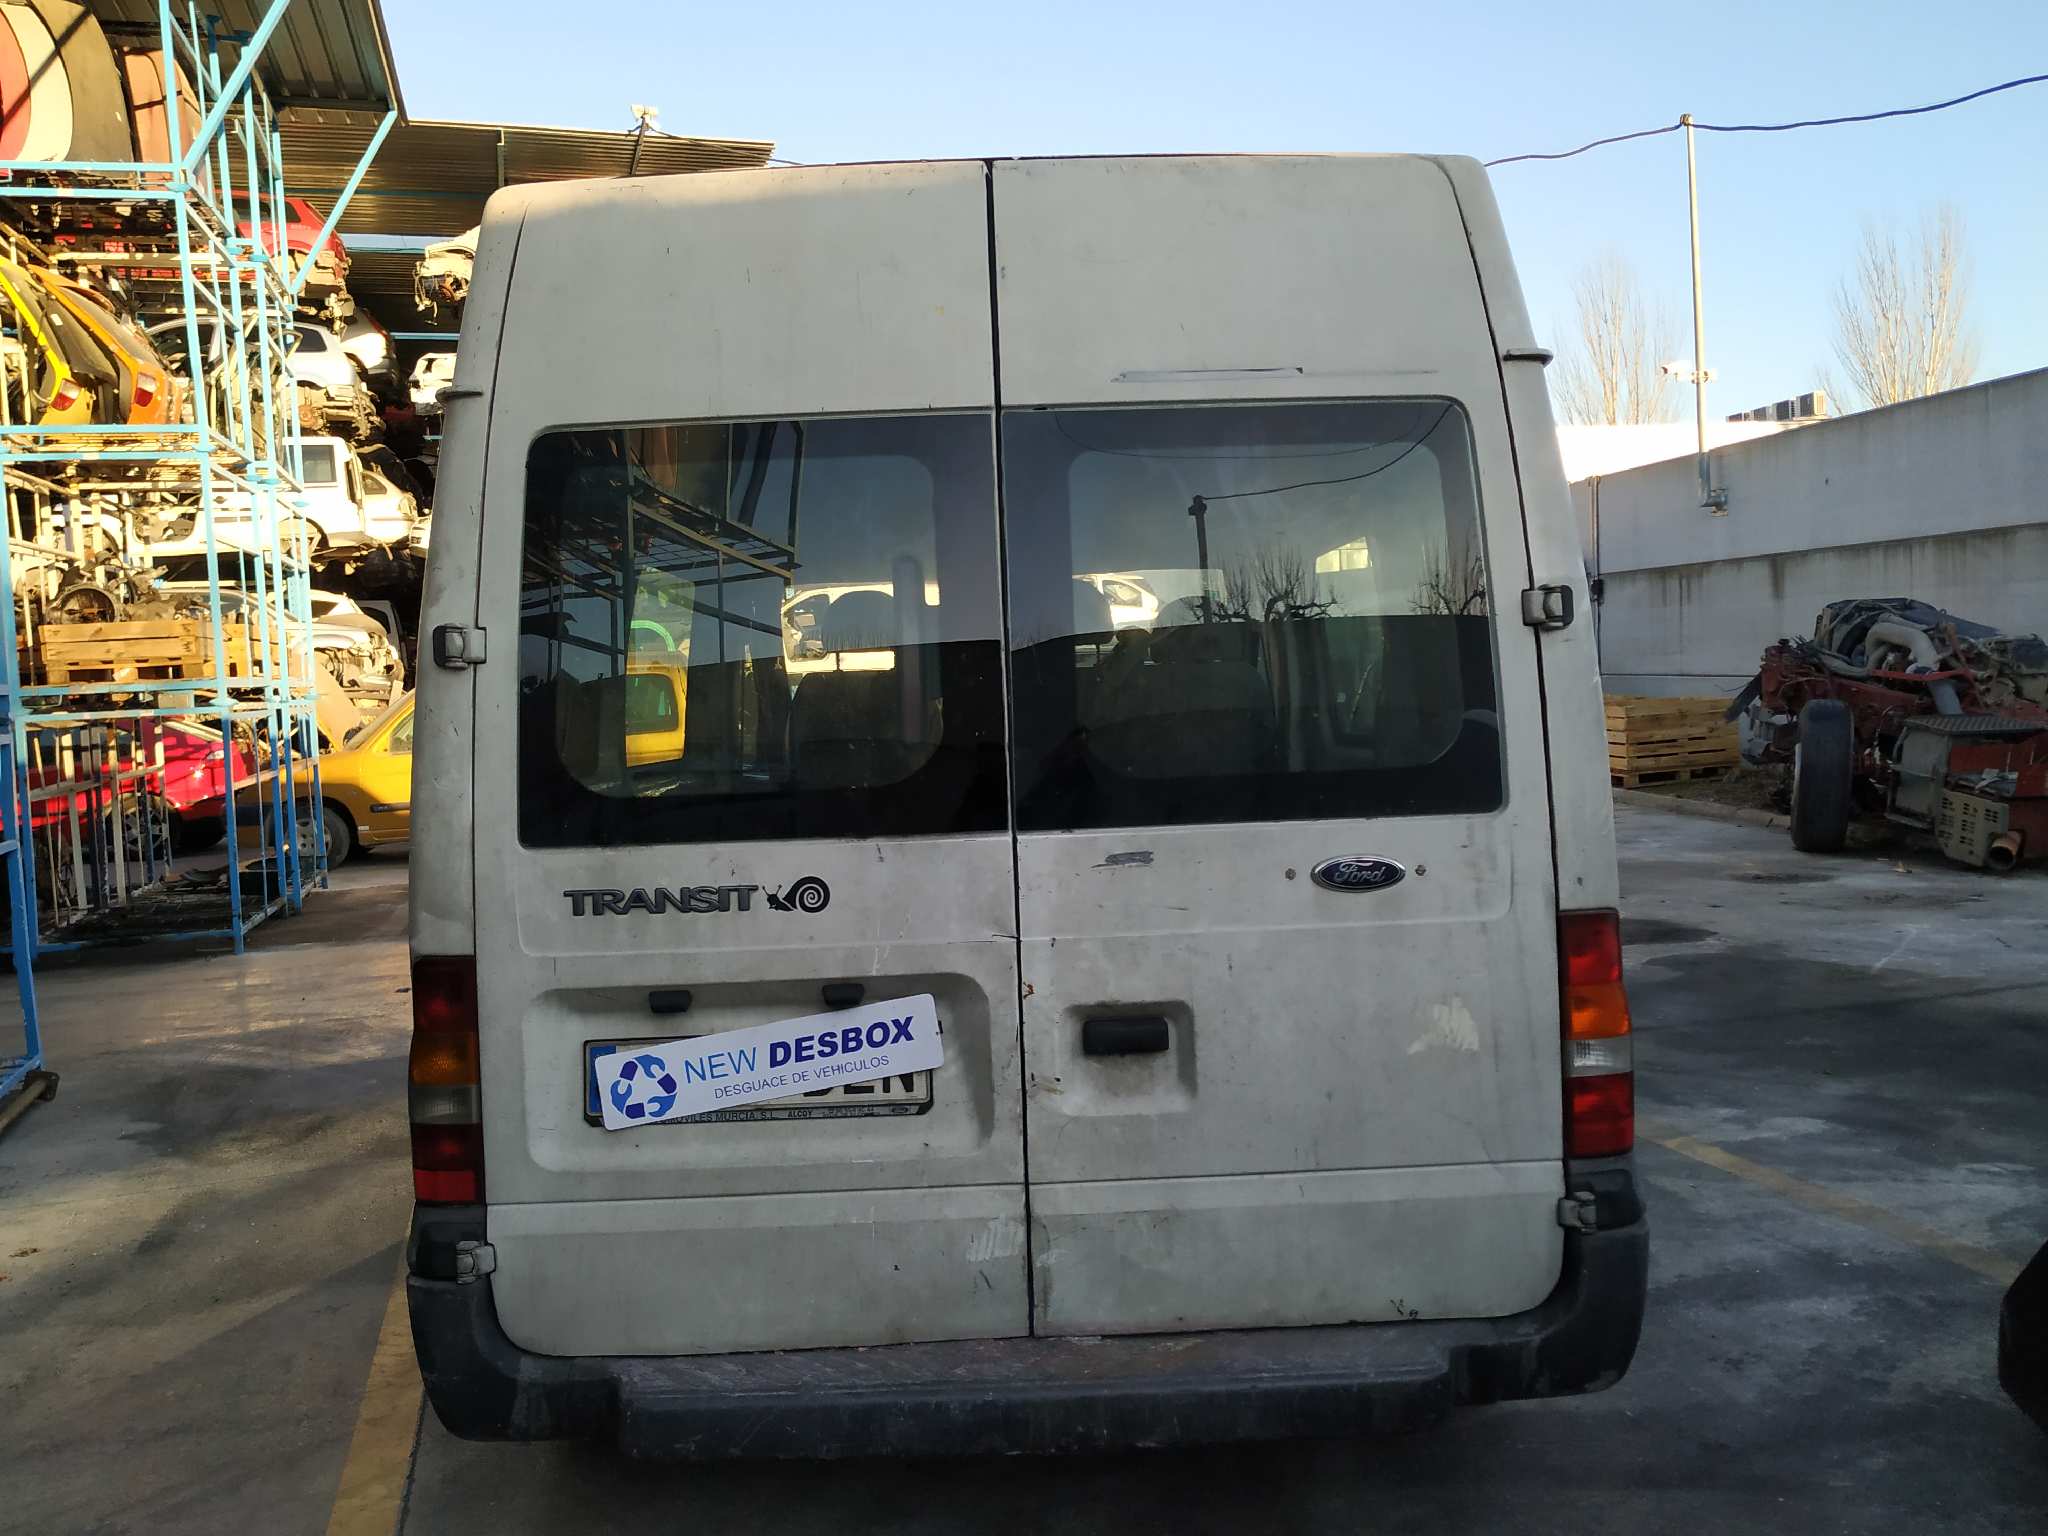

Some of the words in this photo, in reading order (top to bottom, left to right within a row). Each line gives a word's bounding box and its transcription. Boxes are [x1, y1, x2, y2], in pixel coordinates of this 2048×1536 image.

[1335, 861, 1386, 883] Ford
[563, 885, 759, 917] TRANSIT
[684, 1047, 757, 1084] NEW
[768, 1015, 916, 1069] DESBOX
[714, 1075, 789, 1100] DESGUACE
[791, 1071, 811, 1084] DE
[813, 1054, 890, 1080] VEHICULOS
[788, 1110, 812, 1119] ALCOY
